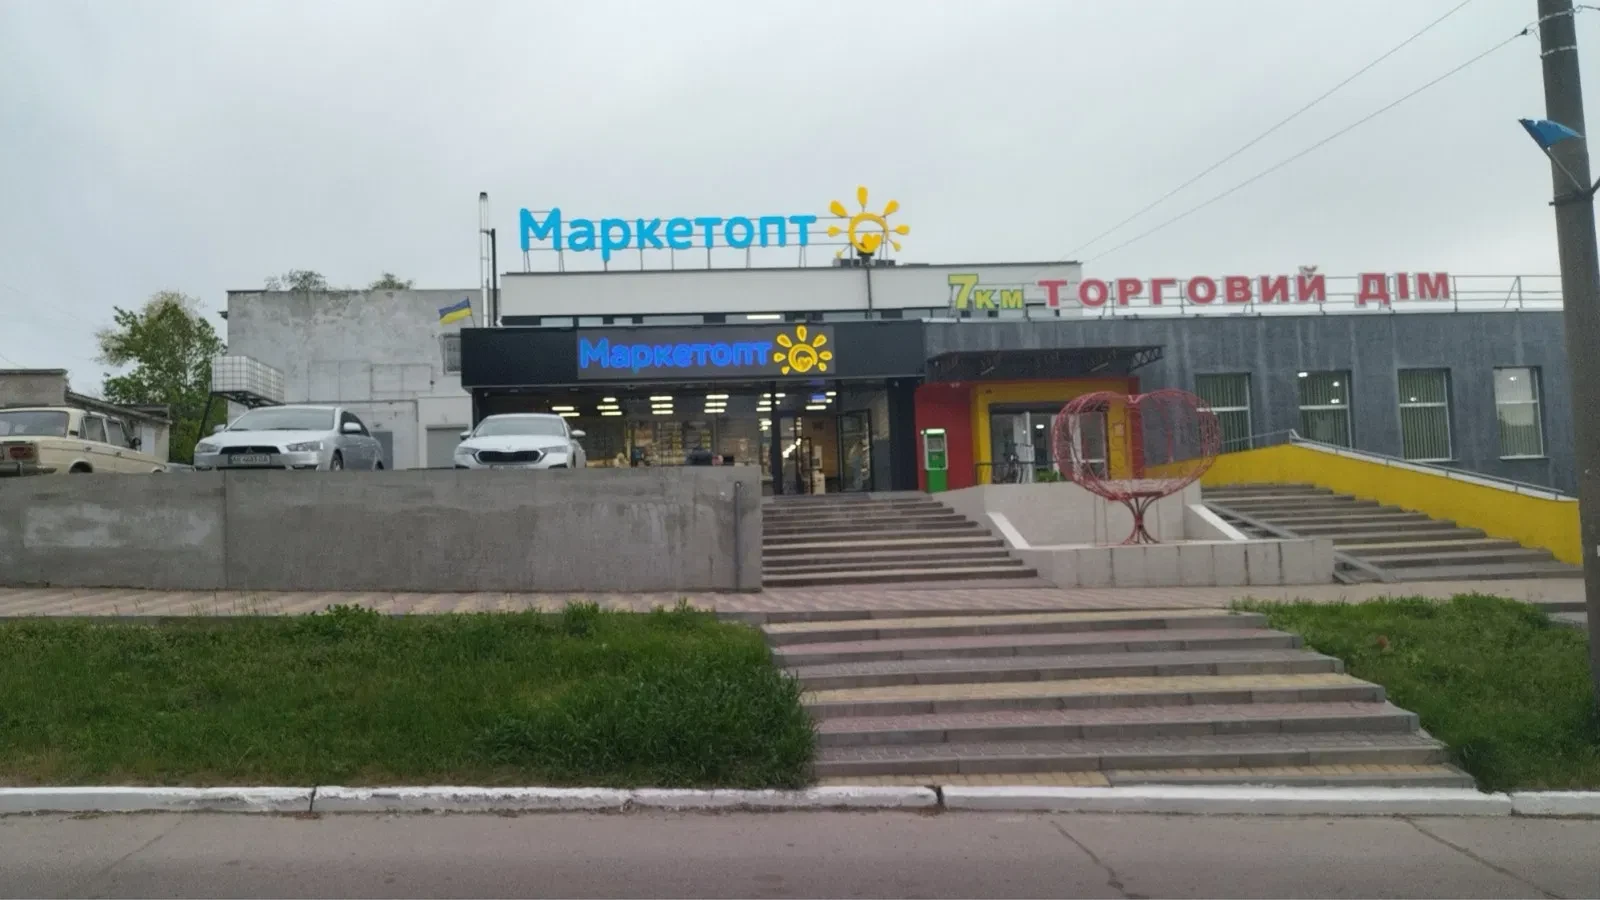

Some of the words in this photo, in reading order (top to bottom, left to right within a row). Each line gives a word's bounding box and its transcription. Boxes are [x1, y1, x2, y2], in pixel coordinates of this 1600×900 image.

[520, 207, 817, 261] Маркетопт
[1037, 267, 1327, 308] ТОРГОВИЙ
[1357, 272, 1452, 307] ДІМ
[579, 338, 772, 373] Маркетопт
